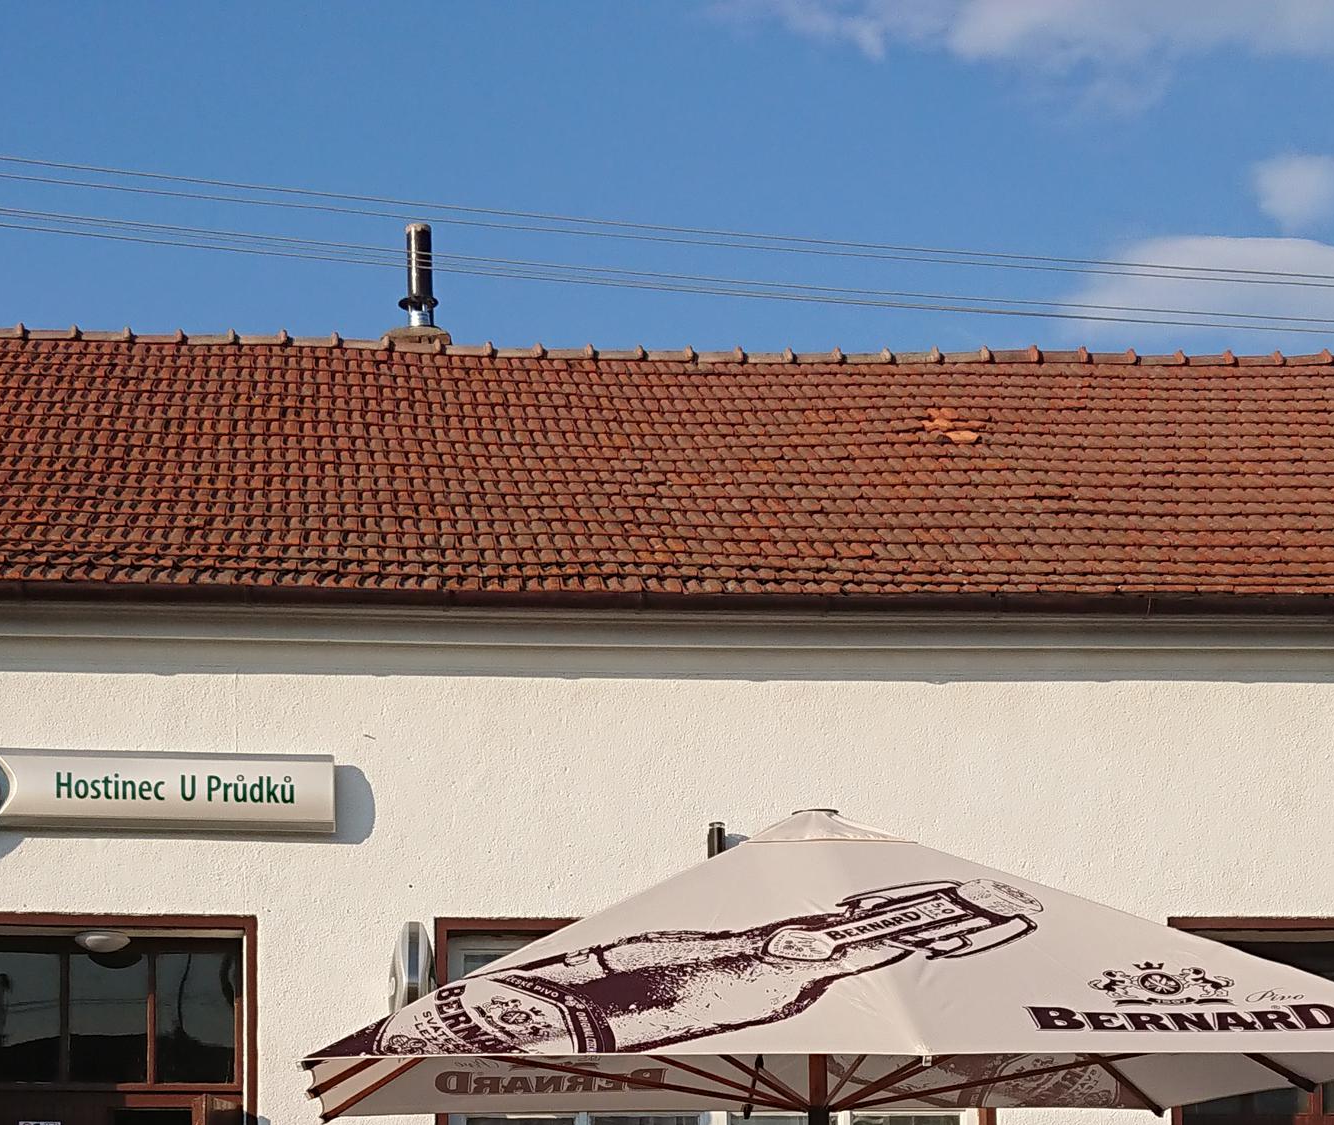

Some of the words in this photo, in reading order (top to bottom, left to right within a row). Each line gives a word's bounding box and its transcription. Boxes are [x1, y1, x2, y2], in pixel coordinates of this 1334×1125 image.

[56, 772, 165, 802] Hostinec
[181, 775, 197, 802] U
[207, 774, 296, 805] Průdků
[826, 910, 922, 942] BERNARD
[534, 984, 560, 999] PIVO
[1244, 988, 1305, 1004] Pivo
